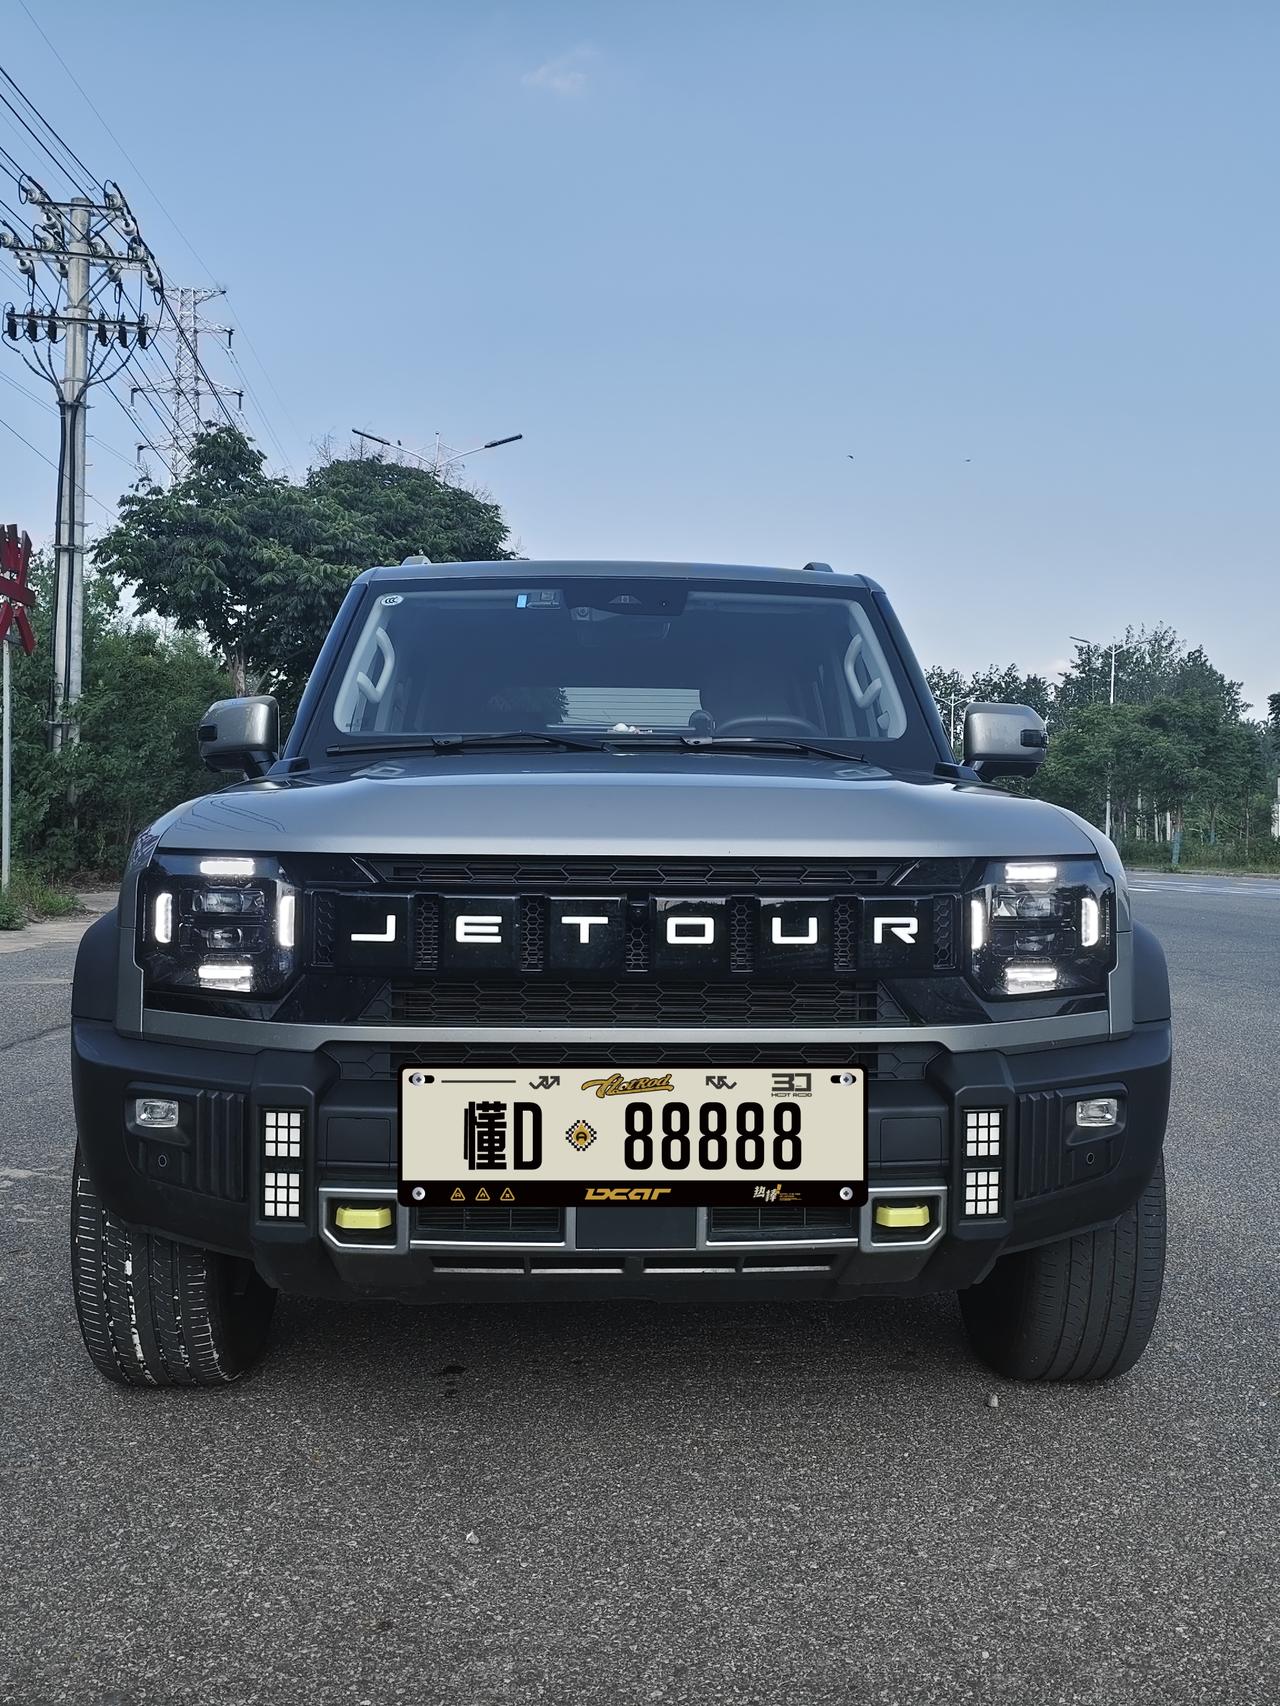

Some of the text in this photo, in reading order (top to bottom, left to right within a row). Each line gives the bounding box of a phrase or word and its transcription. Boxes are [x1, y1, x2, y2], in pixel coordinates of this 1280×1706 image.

[351, 914, 918, 944] JETOUR
[464, 1101, 801, 1170] 懂D 88888
